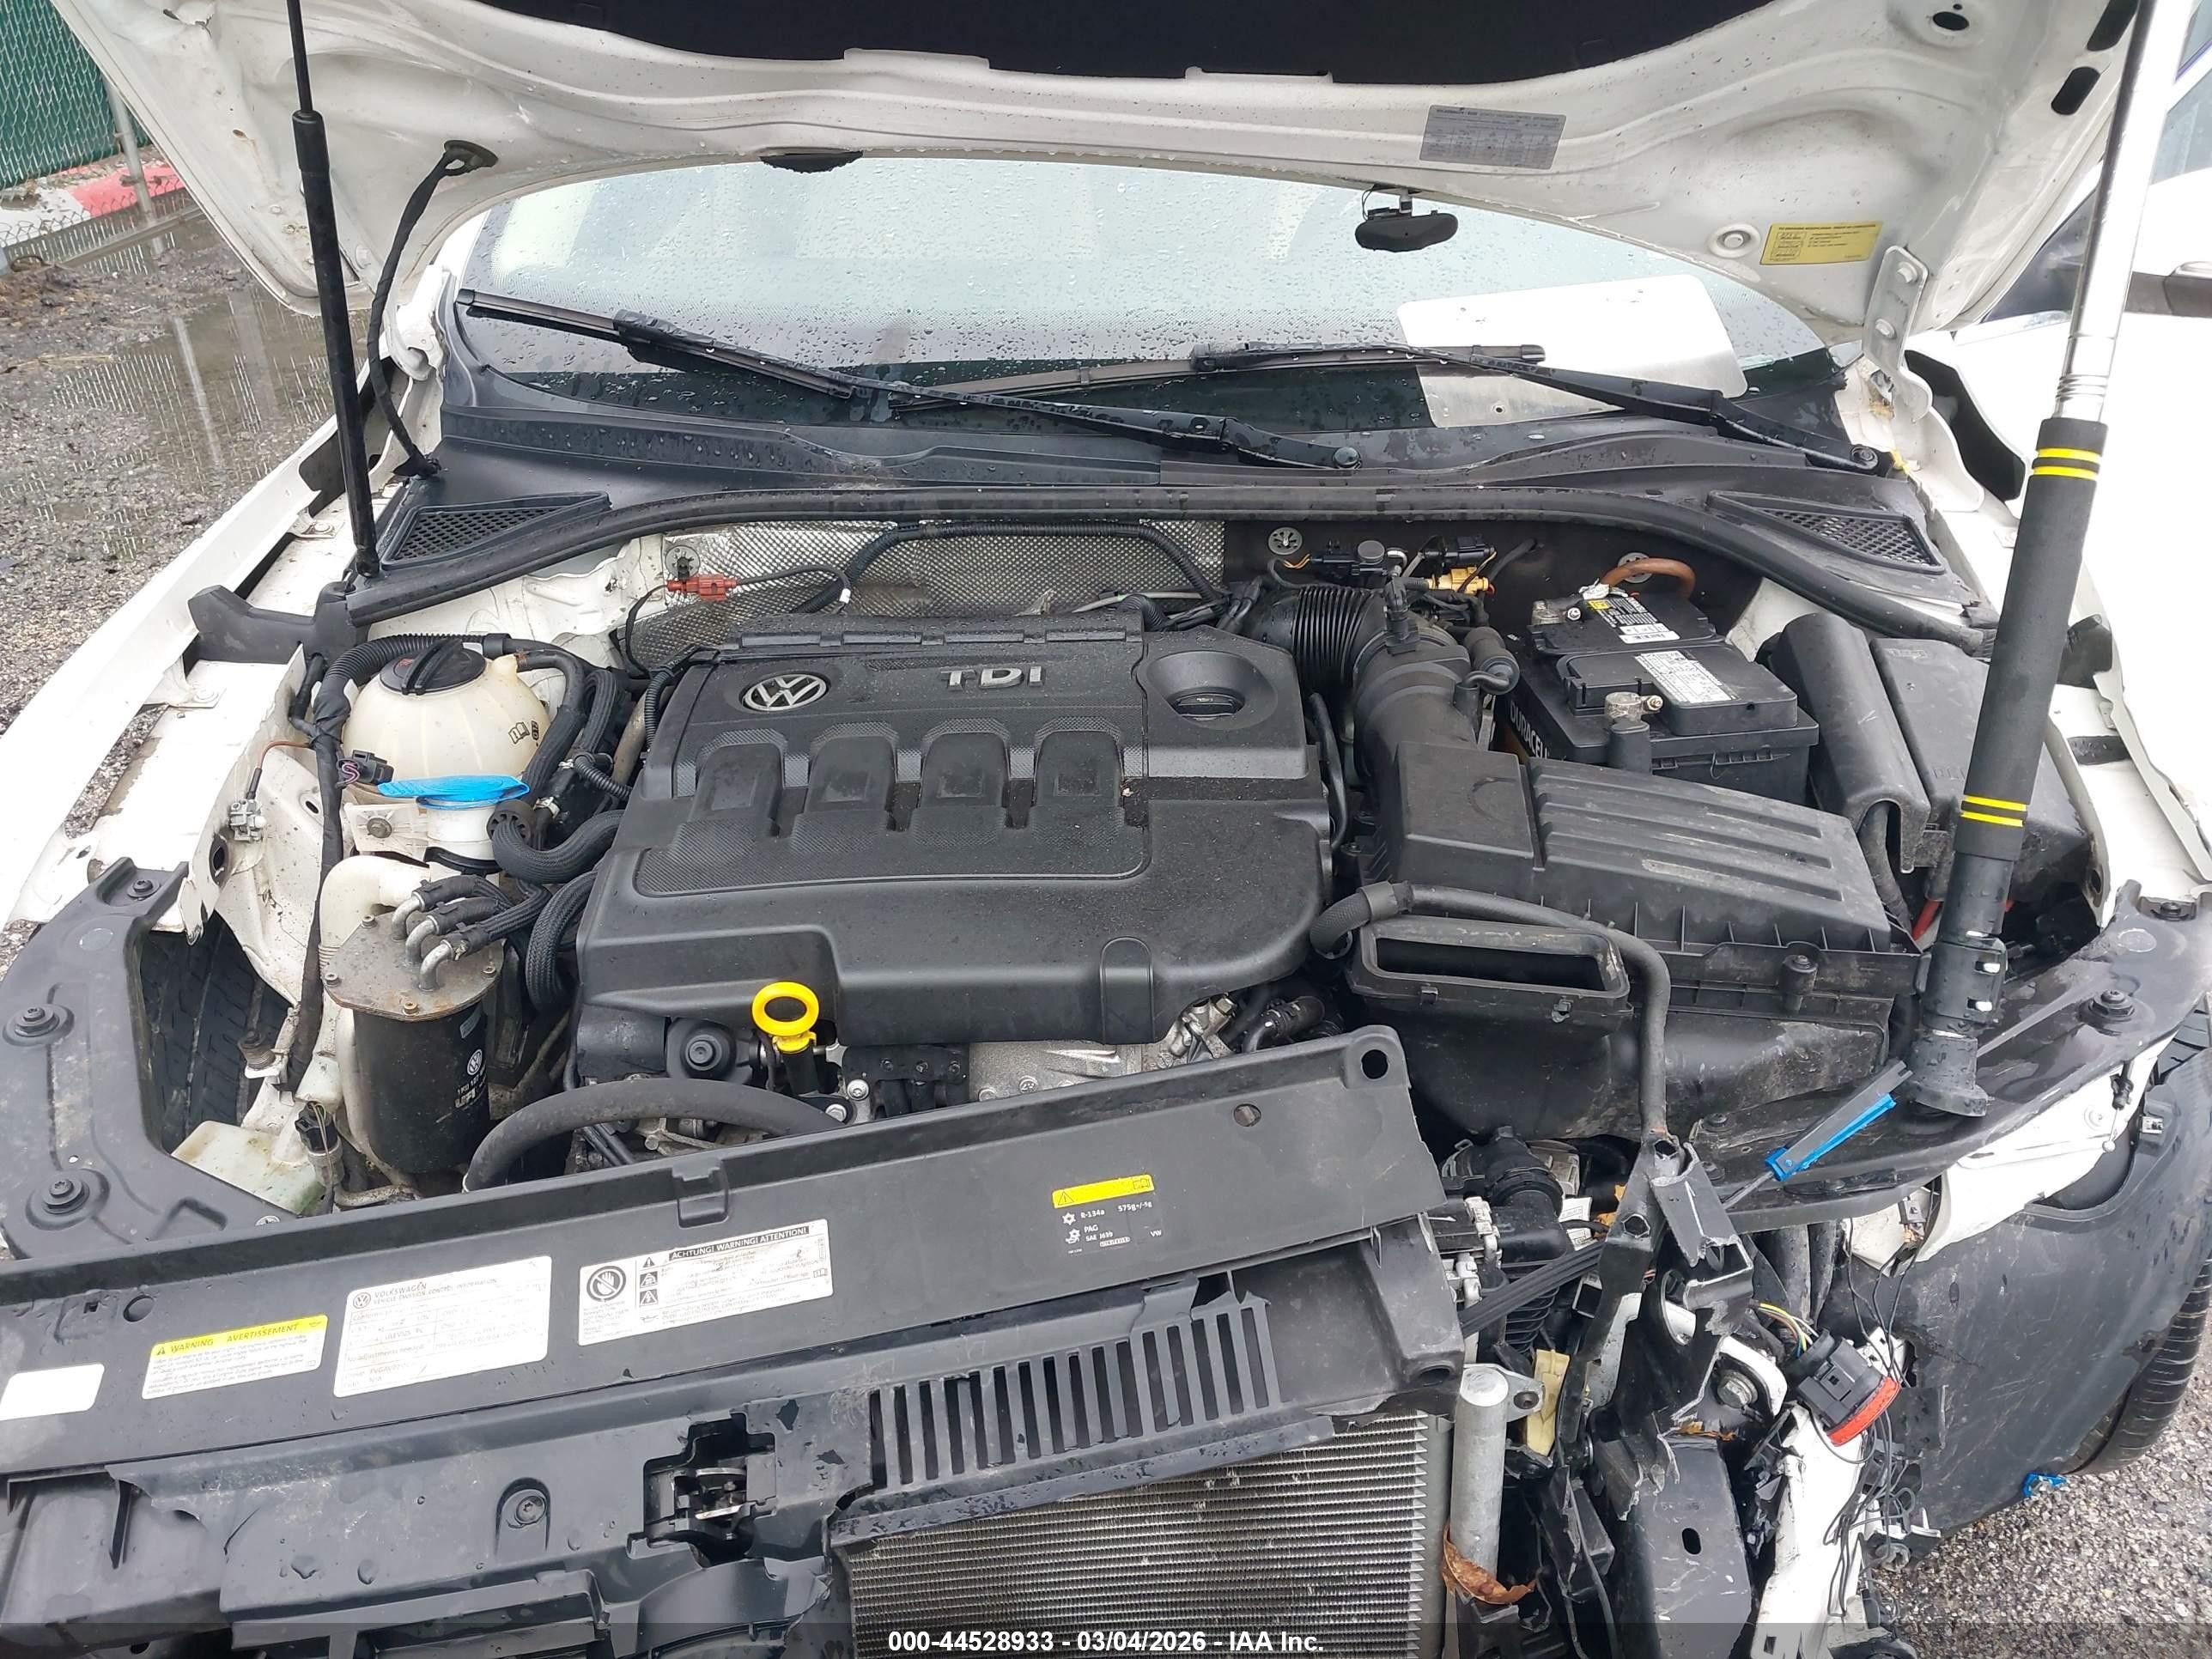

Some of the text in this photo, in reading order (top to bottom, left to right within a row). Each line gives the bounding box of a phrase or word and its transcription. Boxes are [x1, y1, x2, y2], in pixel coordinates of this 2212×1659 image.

[940, 665, 1045, 691] TDI
[1080, 1209, 1105, 1219] R-134a
[1084, 1224, 1098, 1233] PAG
[672, 1226, 807, 1260] ACHTUNG! WARNING! ATTENTION!
[374, 1282, 428, 1298] VOLKSWAGEN
[171, 1323, 300, 1353] WARNING AVERTISSEMENT
